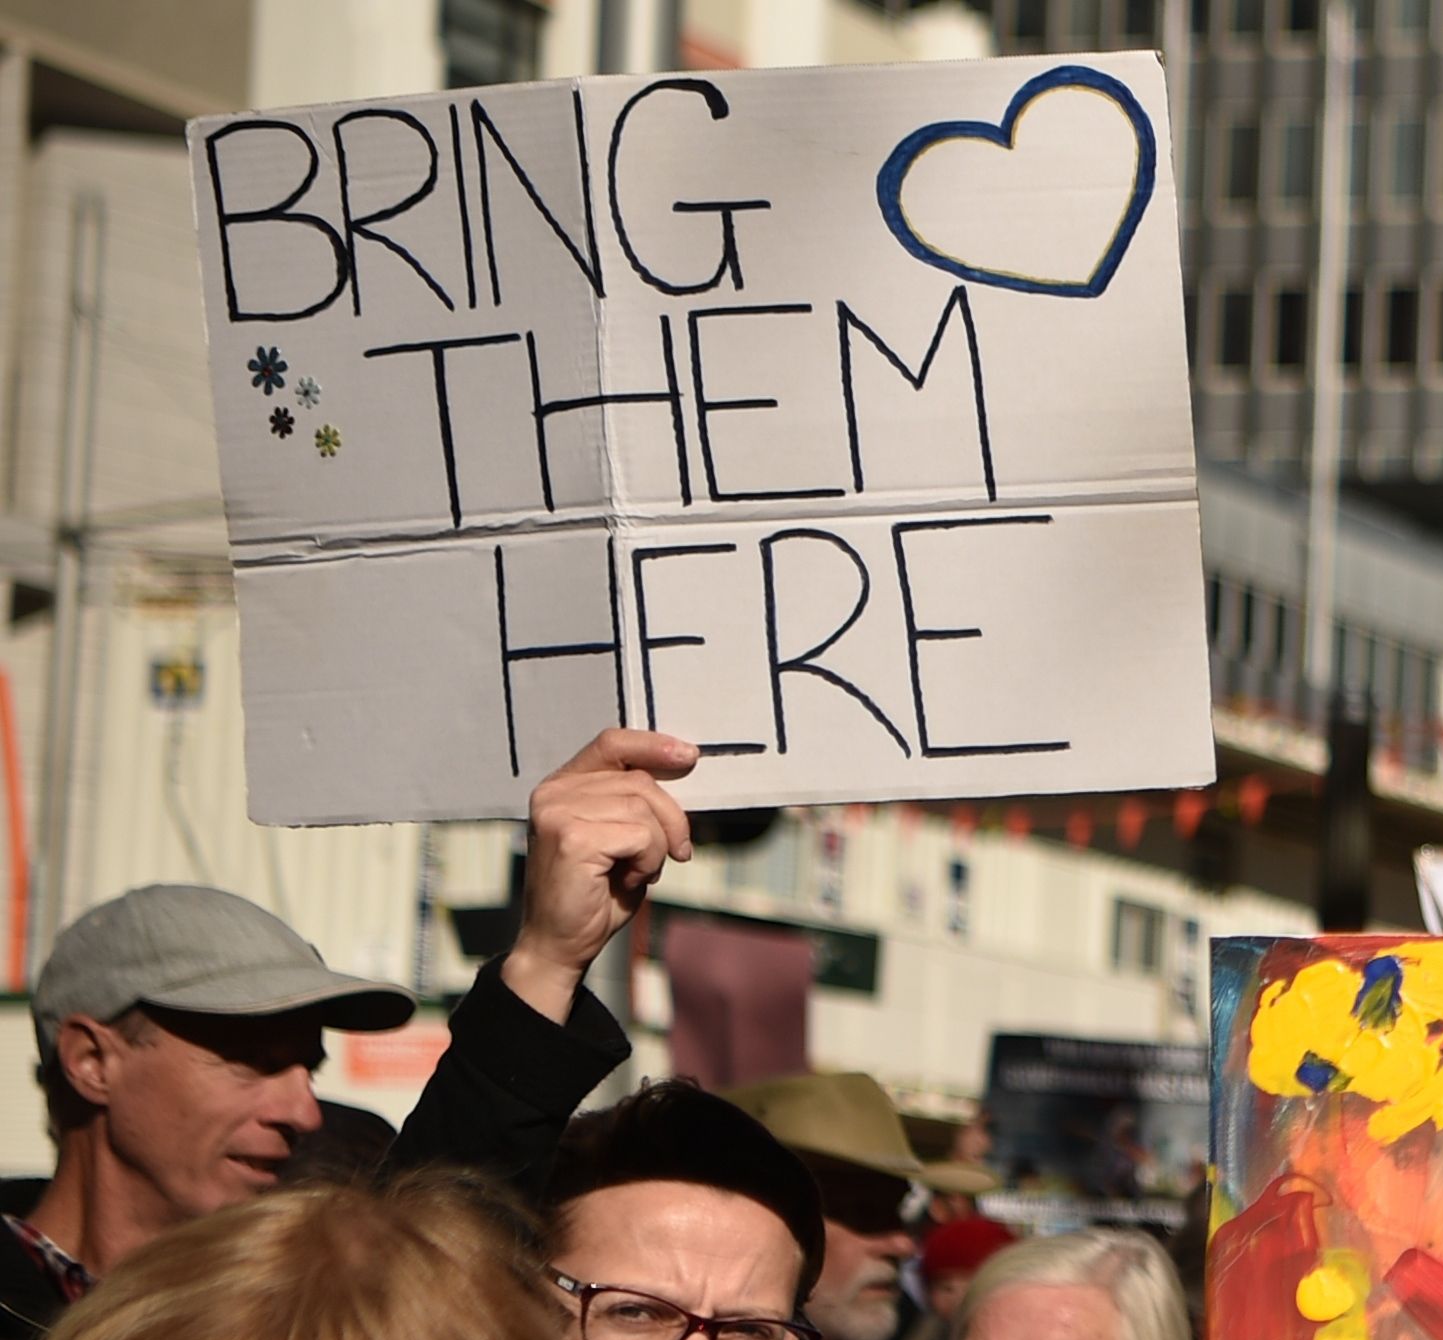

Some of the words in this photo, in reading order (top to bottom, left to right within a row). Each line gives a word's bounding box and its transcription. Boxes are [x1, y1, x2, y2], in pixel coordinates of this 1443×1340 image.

[205, 78, 771, 322] BRING
[364, 284, 996, 528] THEM
[495, 517, 1071, 777] HERE
